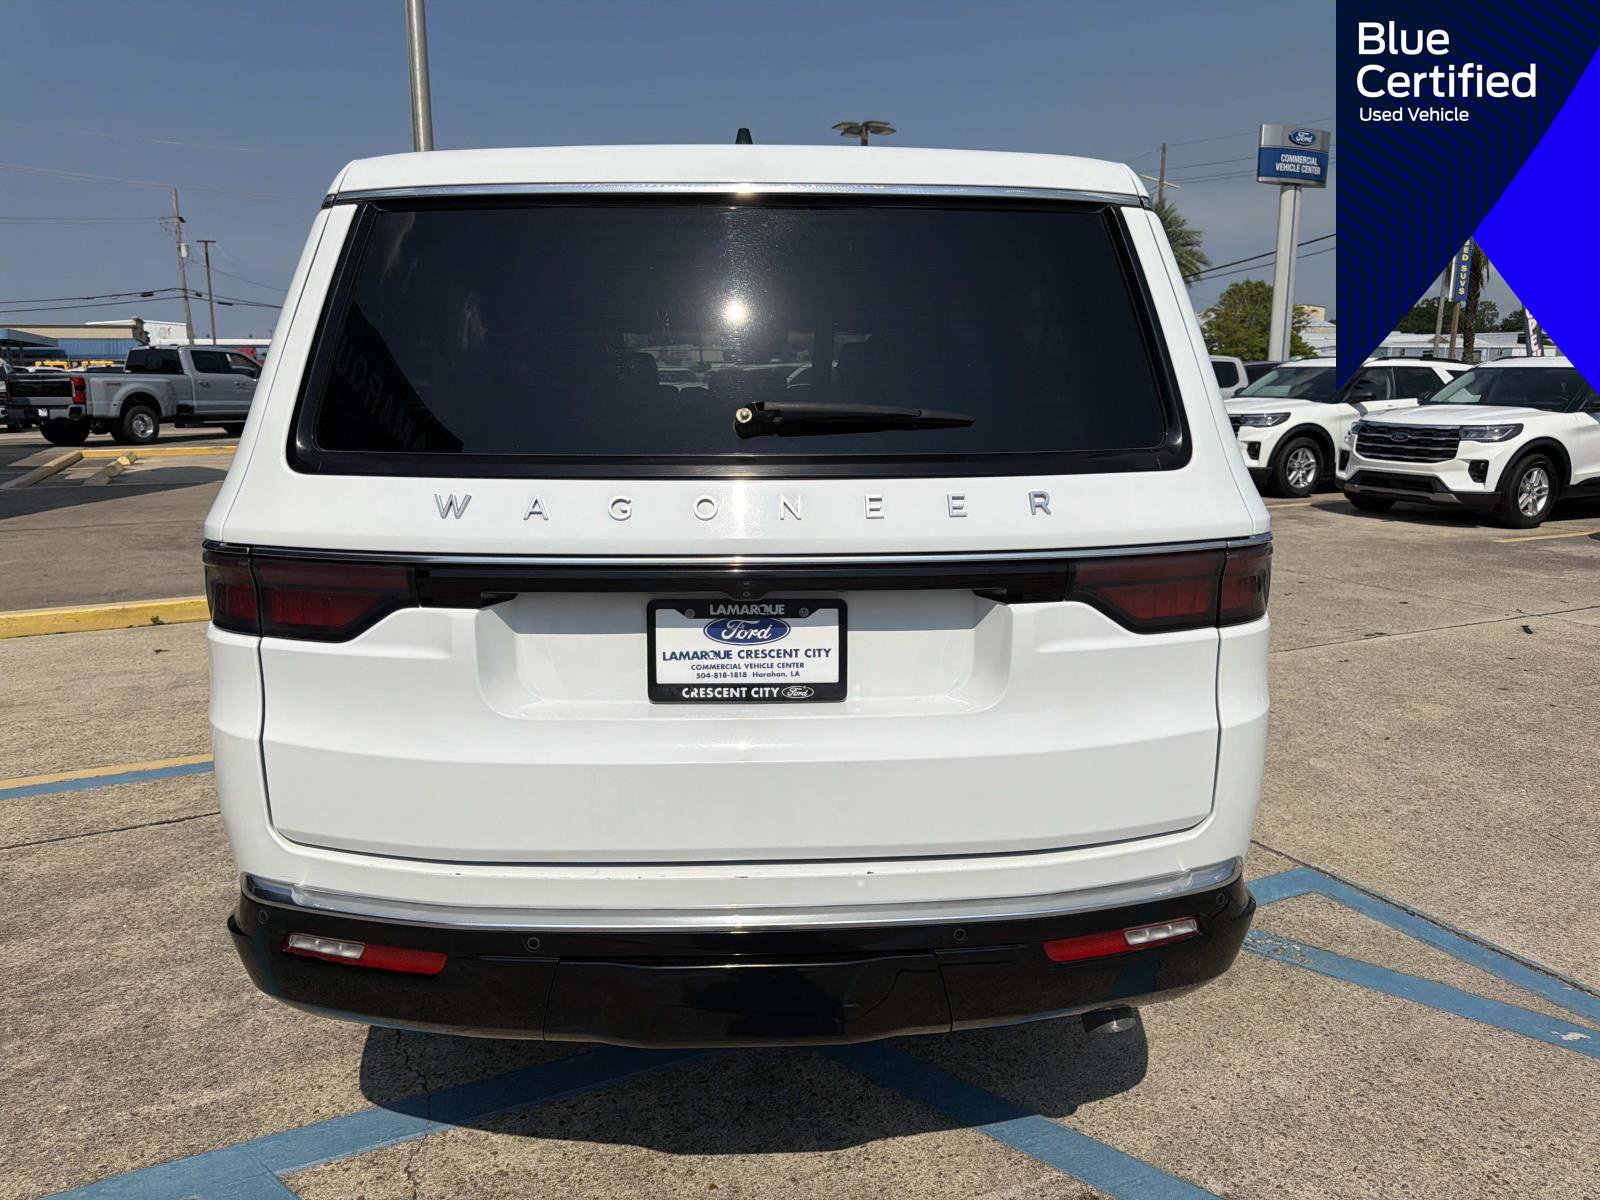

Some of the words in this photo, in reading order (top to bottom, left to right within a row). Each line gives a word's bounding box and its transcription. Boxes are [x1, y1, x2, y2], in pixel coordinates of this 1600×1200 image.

[1294, 131, 1315, 143] Ford
[1280, 153, 1319, 166] COMMERCIAL
[1275, 162, 1301, 173] VEHICLE
[1301, 164, 1322, 176] CENTER
[1458, 264, 1469, 295] SUVS
[433, 490, 1052, 522] WAGONEER
[709, 603, 785, 616] LAMARQUE
[721, 619, 774, 641] Ford
[662, 649, 733, 662] LAMARQUE
[737, 648, 800, 660] CRESCENT
[804, 647, 832, 658] CITY
[690, 663, 742, 671] COMMERCIAL
[744, 662, 775, 670] VEHICLE
[695, 671, 748, 679] 504-818-1818
[752, 670, 788, 678] Harahan,
[681, 687, 748, 699] CRESCENT
[750, 687, 780, 698] CITY
